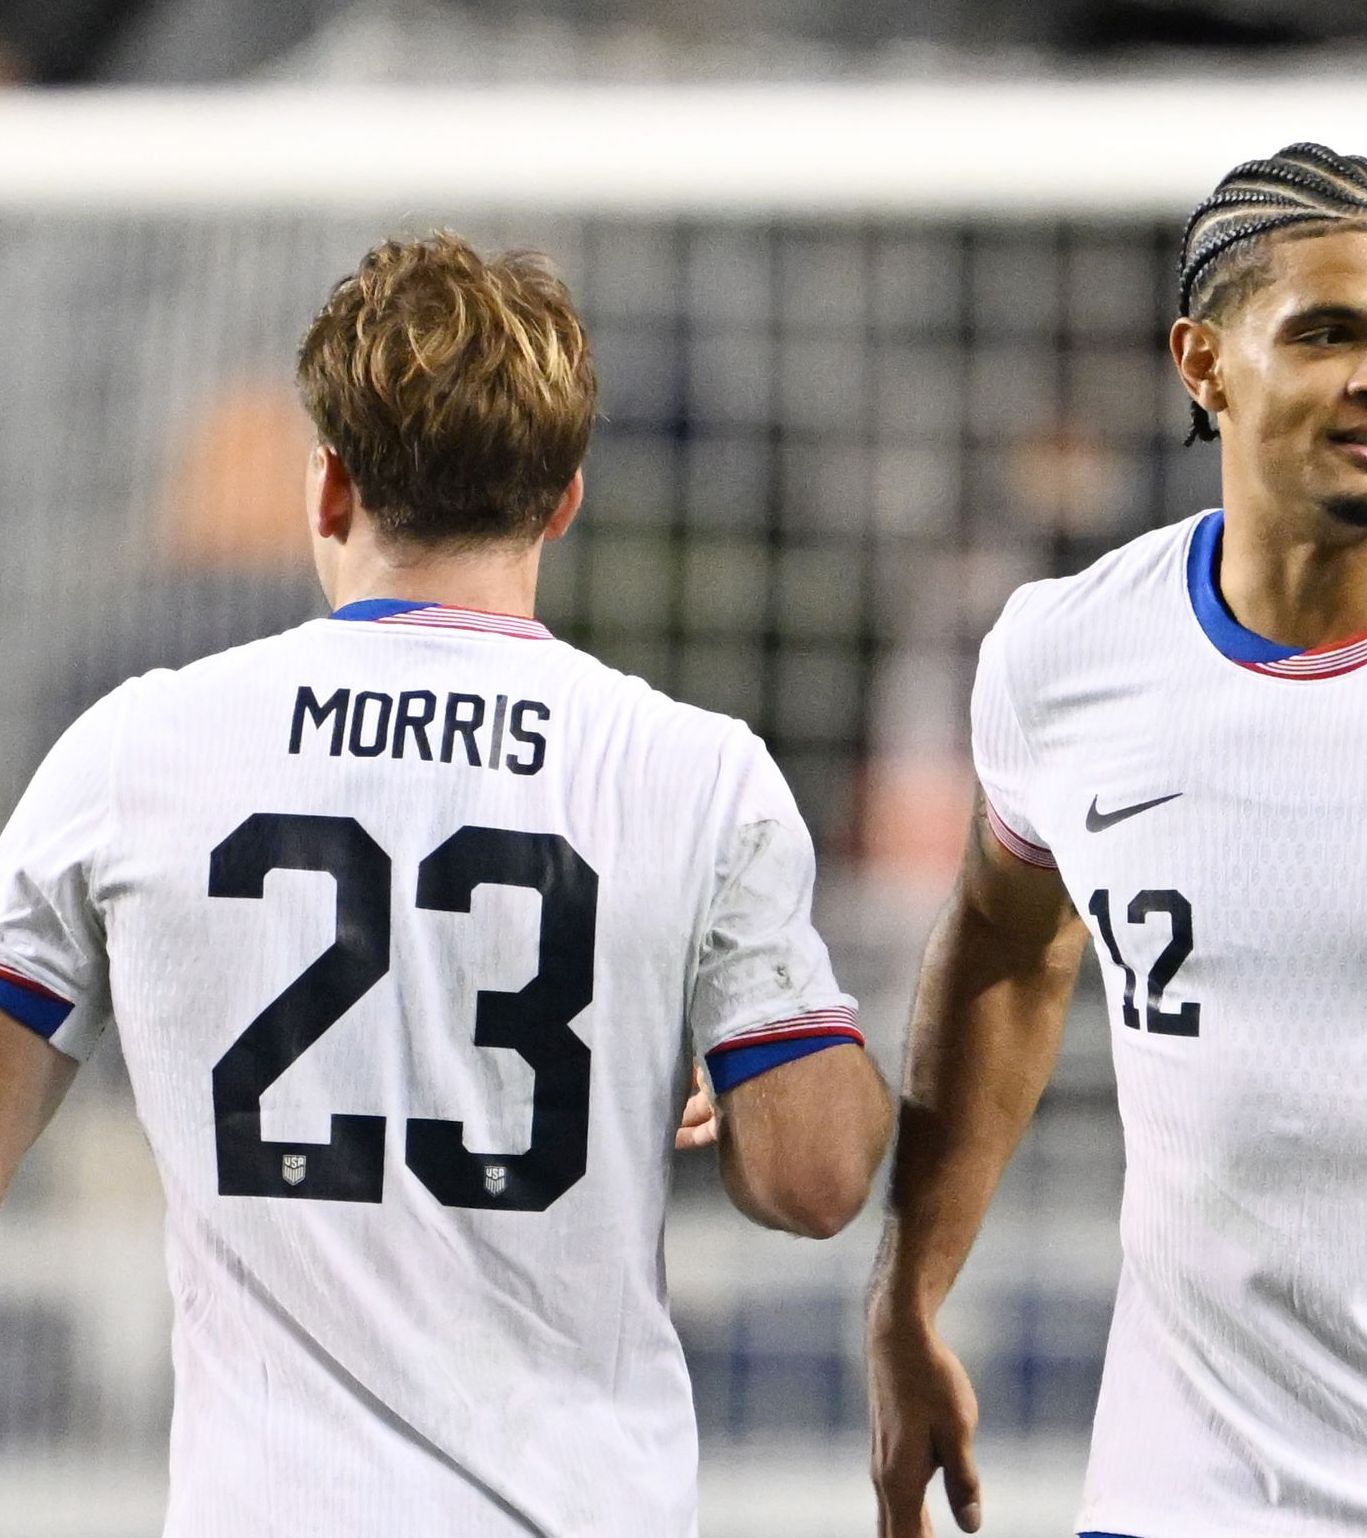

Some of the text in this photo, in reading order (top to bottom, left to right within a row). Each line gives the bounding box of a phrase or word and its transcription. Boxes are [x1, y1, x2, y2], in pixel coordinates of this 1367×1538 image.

[289, 687, 550, 776] MORRIS
[1089, 888, 1200, 1037] 12
[208, 813, 599, 1211] 23
[283, 1156, 305, 1169] USA
[485, 1167, 505, 1180] USA
